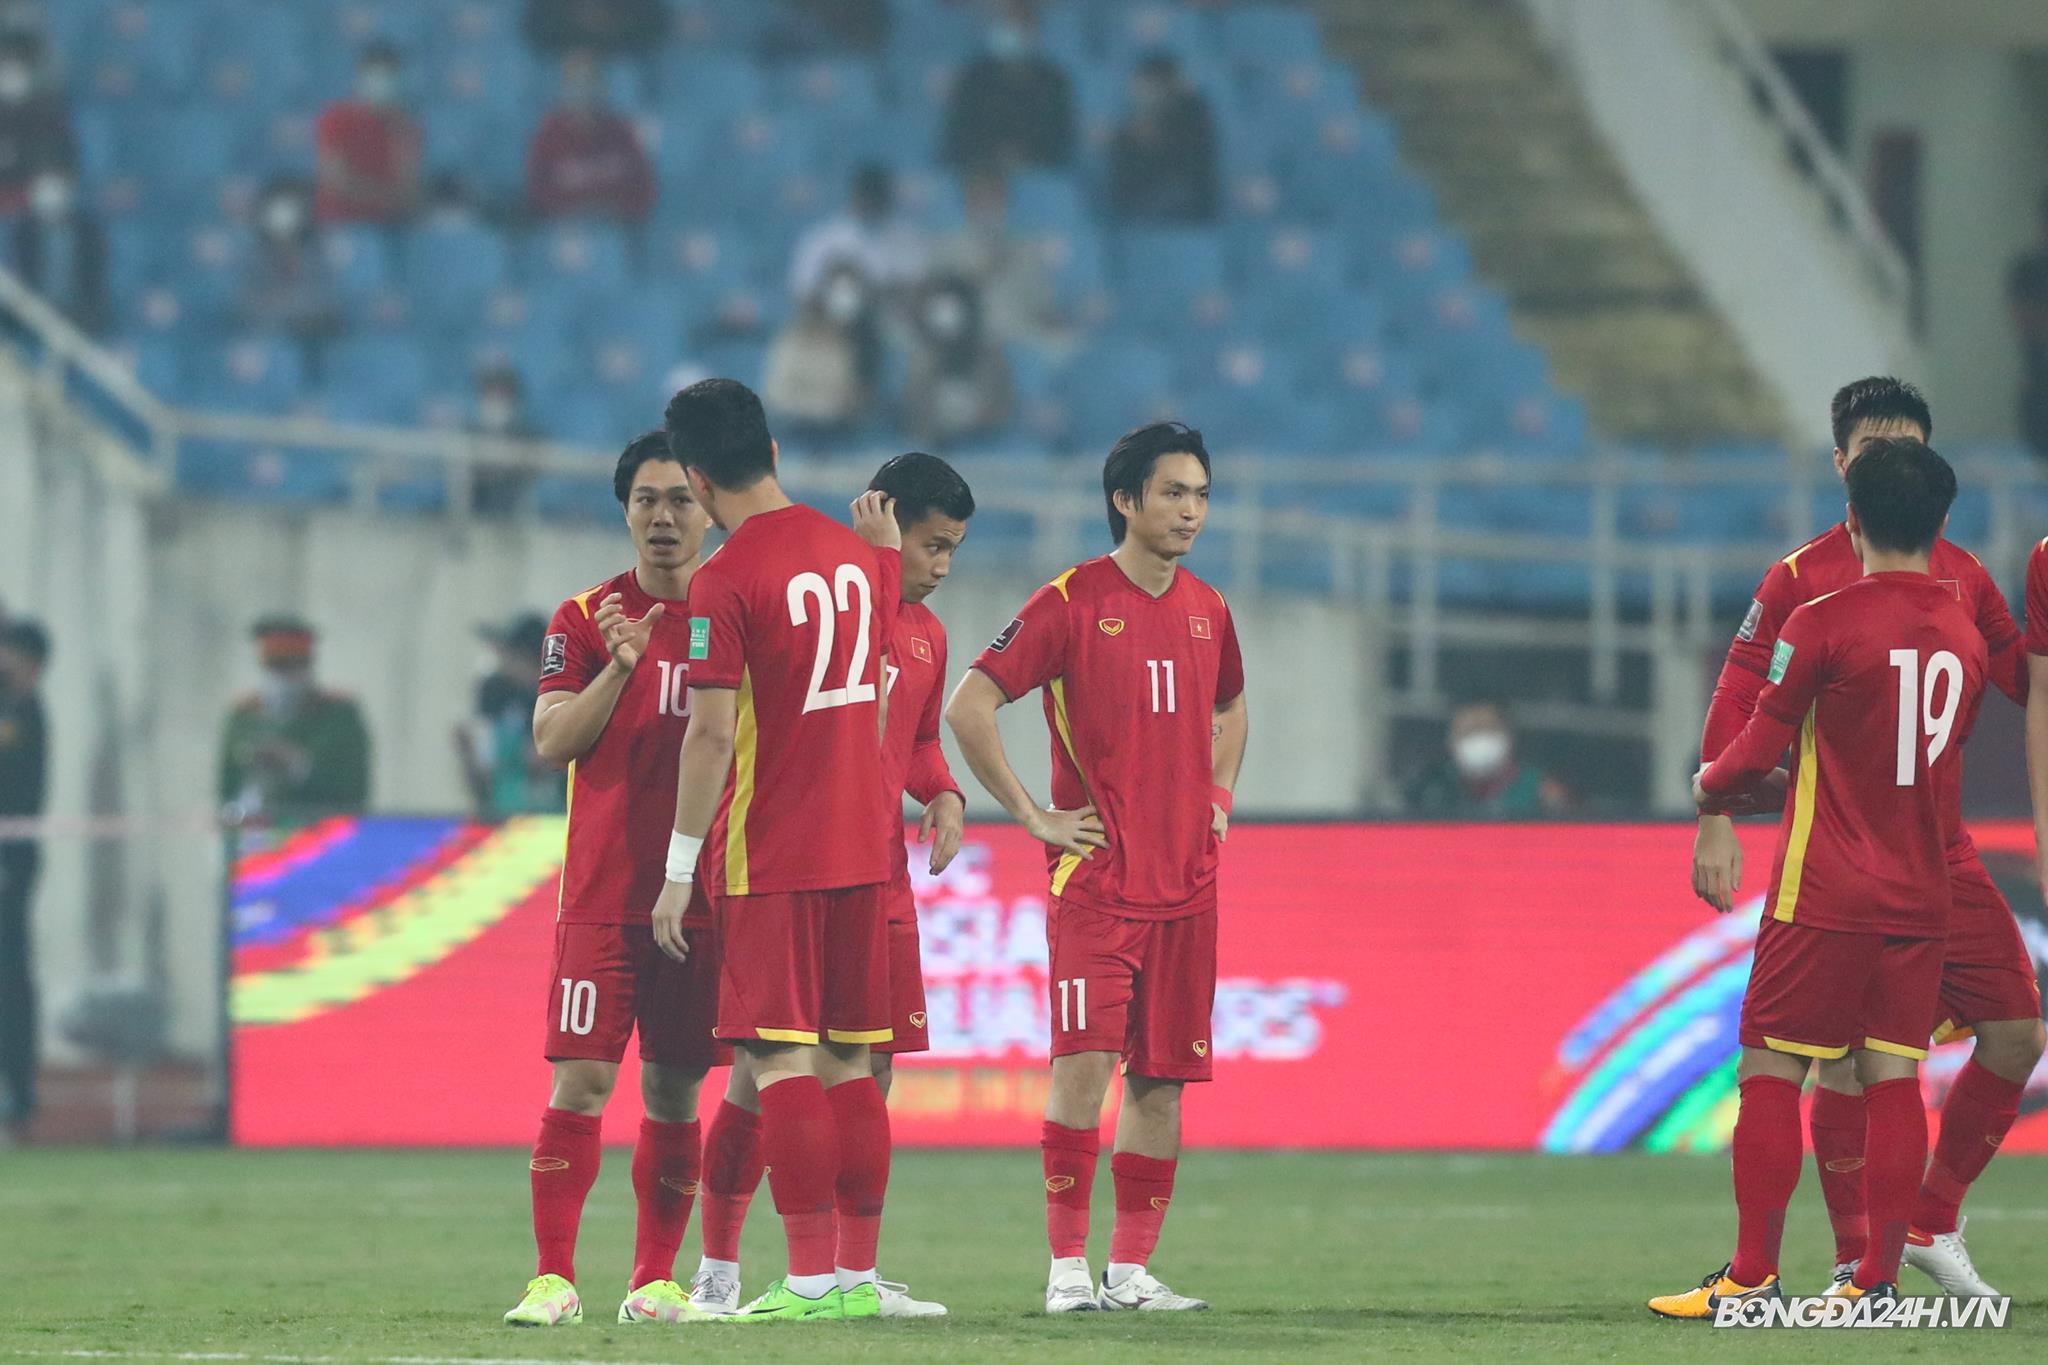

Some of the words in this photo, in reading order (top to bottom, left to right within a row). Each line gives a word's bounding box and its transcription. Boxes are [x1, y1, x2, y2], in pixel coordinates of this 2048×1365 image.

[787, 563, 876, 715] 22
[657, 660, 691, 717] 10
[1146, 660, 1175, 713] 11
[1889, 649, 1964, 786] 19
[560, 978, 597, 1035] 10
[1058, 978, 1086, 1032] 11
